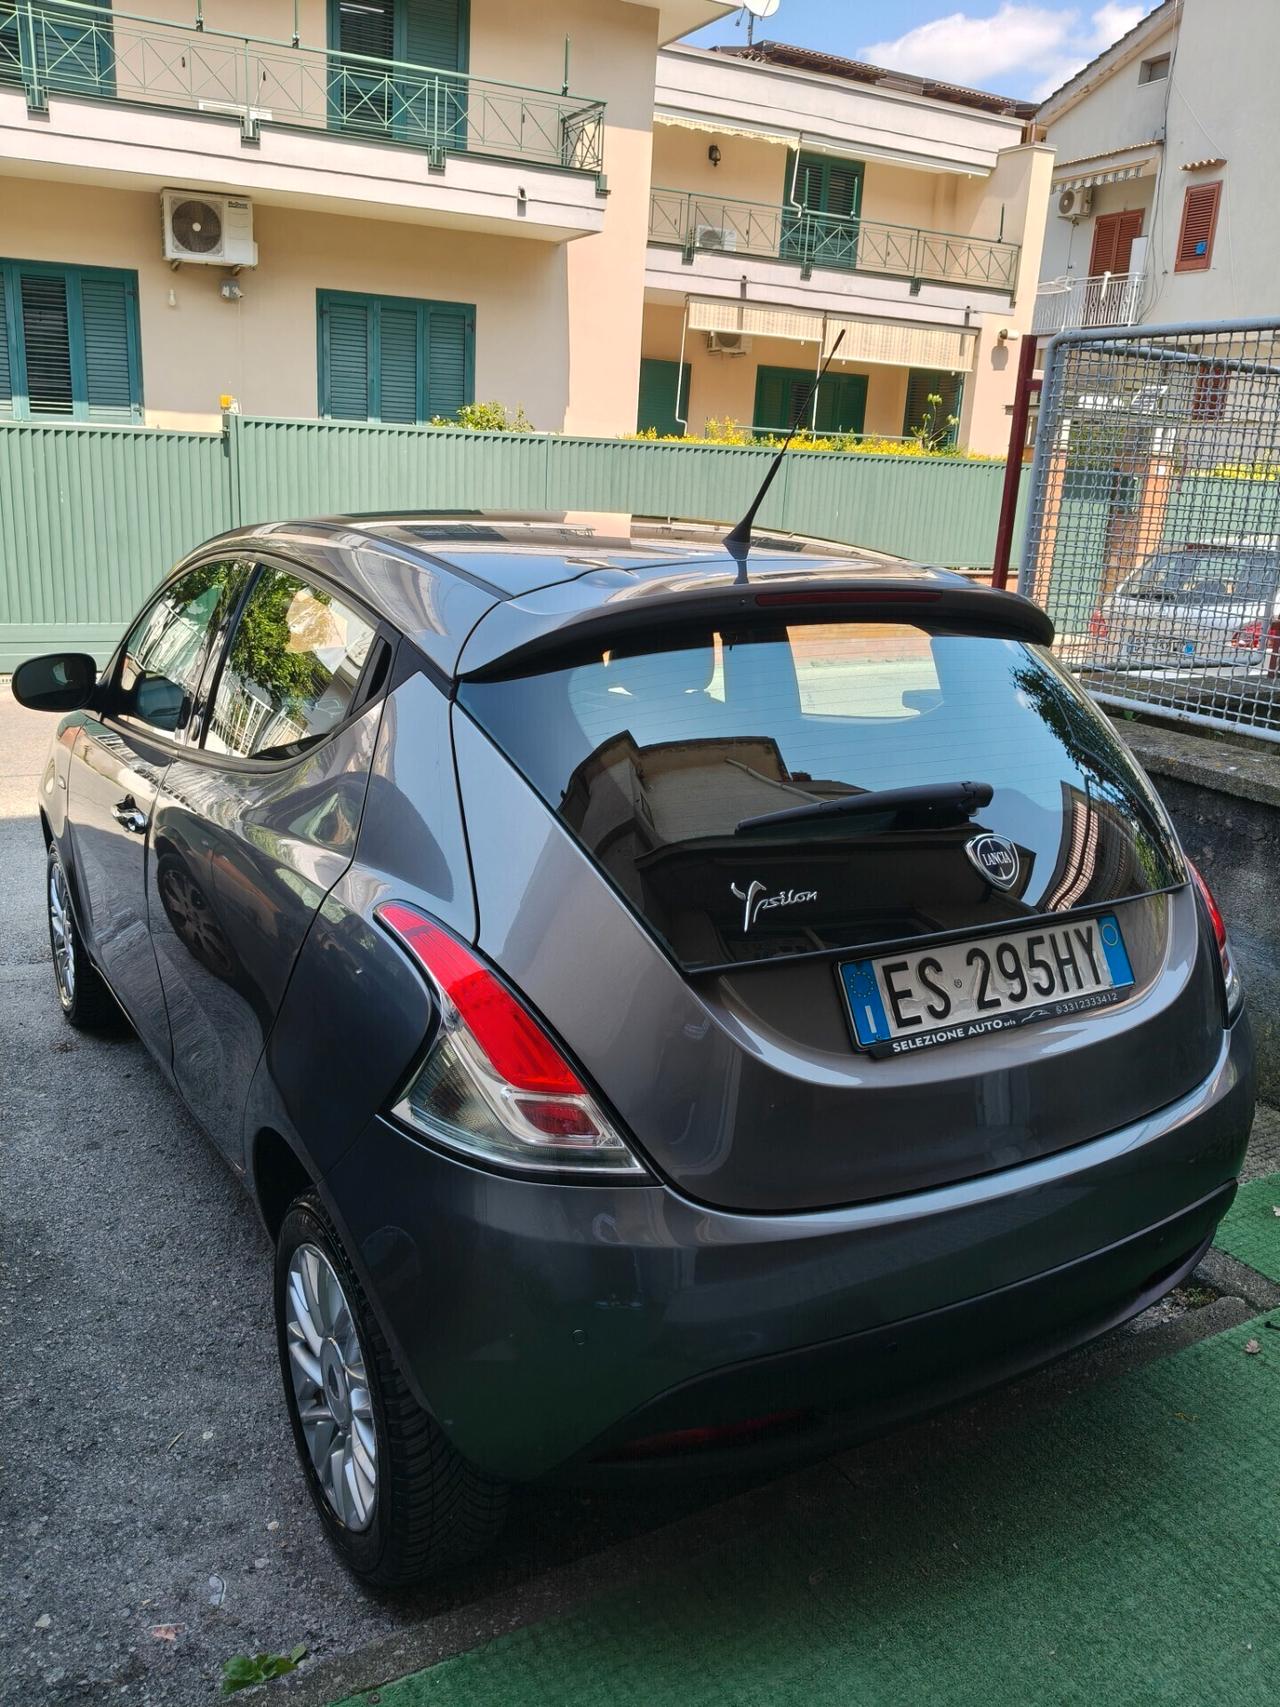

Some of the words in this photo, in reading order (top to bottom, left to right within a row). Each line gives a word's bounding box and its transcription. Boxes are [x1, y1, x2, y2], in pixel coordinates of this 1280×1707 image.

[982, 851, 1012, 866] LANCIA
[730, 880, 818, 933] Ypsilon
[881, 956, 952, 1029] ES
[1062, 992, 1119, 1013] 3312333412
[892, 1028, 965, 1053] SELEZIONE
[967, 1019, 1003, 1036] AUTO
